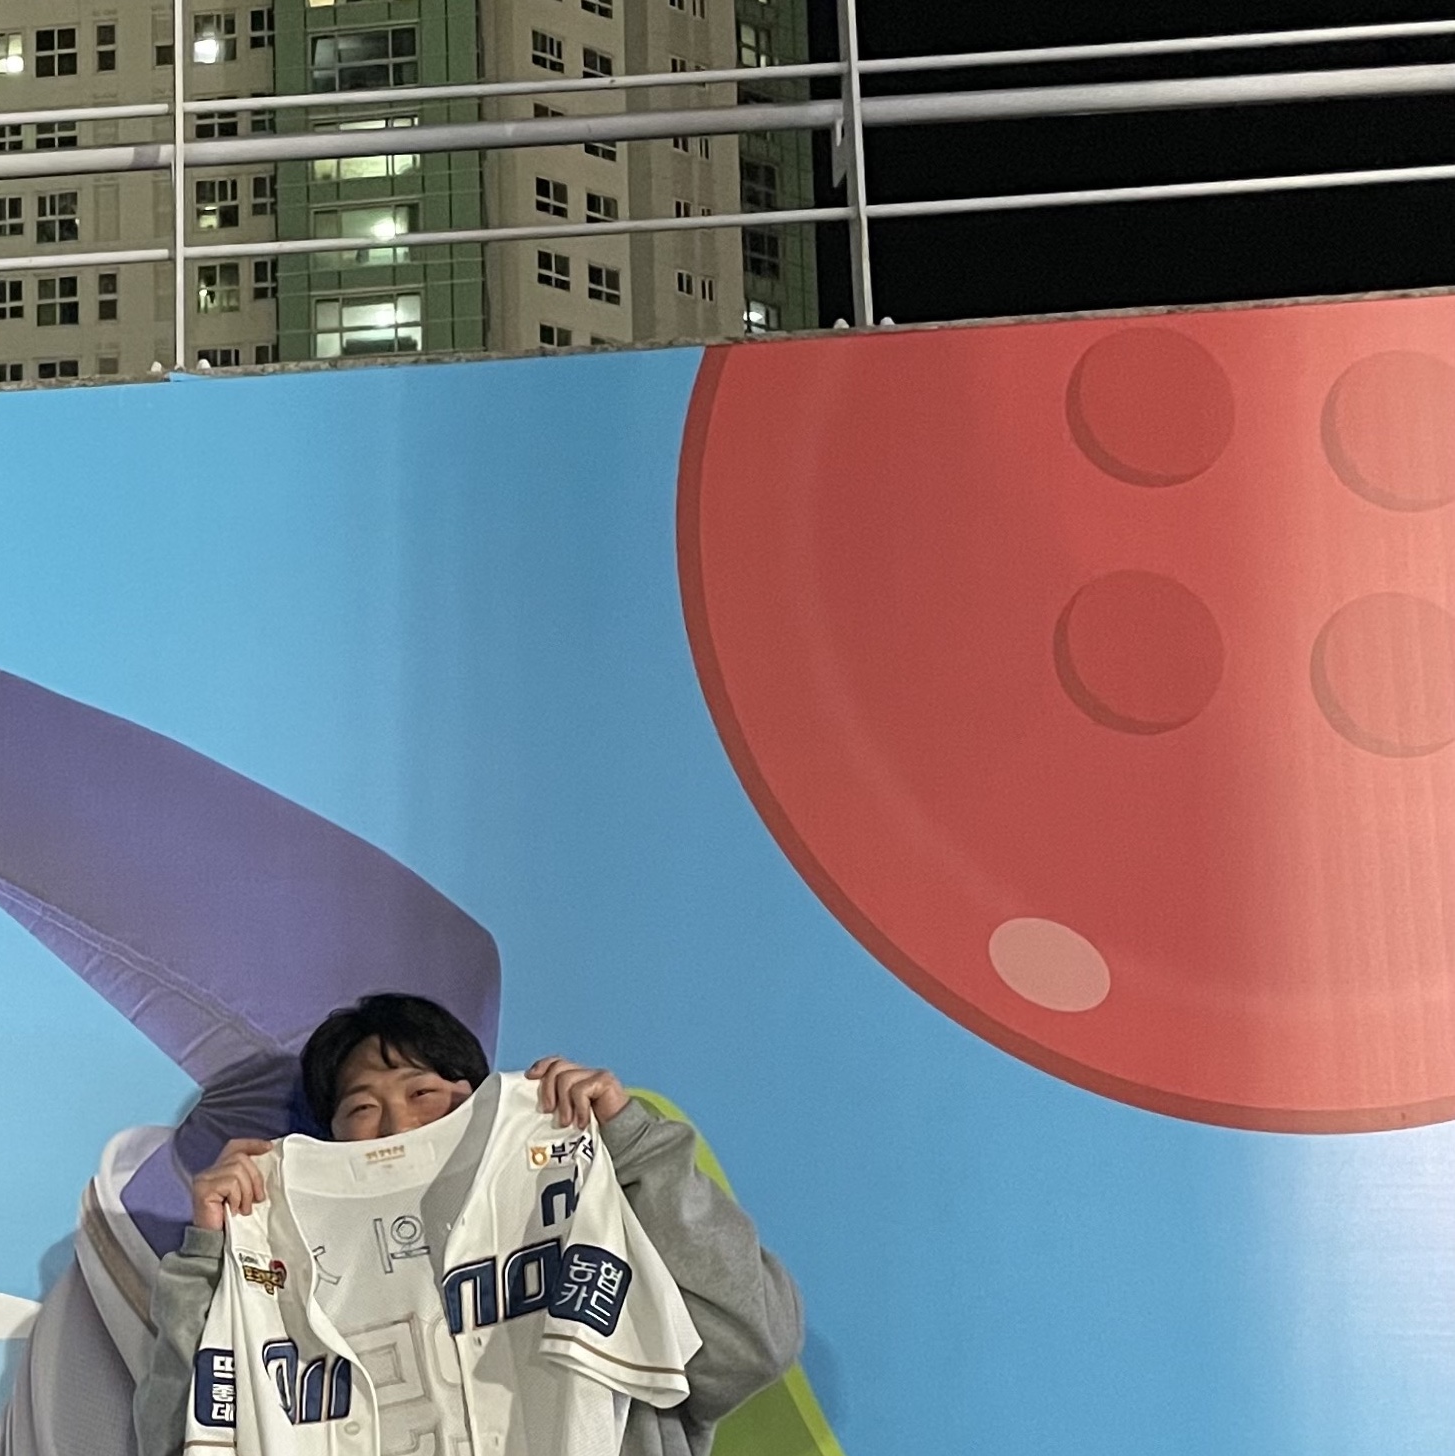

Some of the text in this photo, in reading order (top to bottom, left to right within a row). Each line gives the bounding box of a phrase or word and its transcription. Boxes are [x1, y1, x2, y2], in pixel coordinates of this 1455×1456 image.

[569, 1254, 623, 1297] 농협
[555, 1283, 614, 1326] 카드
[210, 1402, 235, 1422] 데
